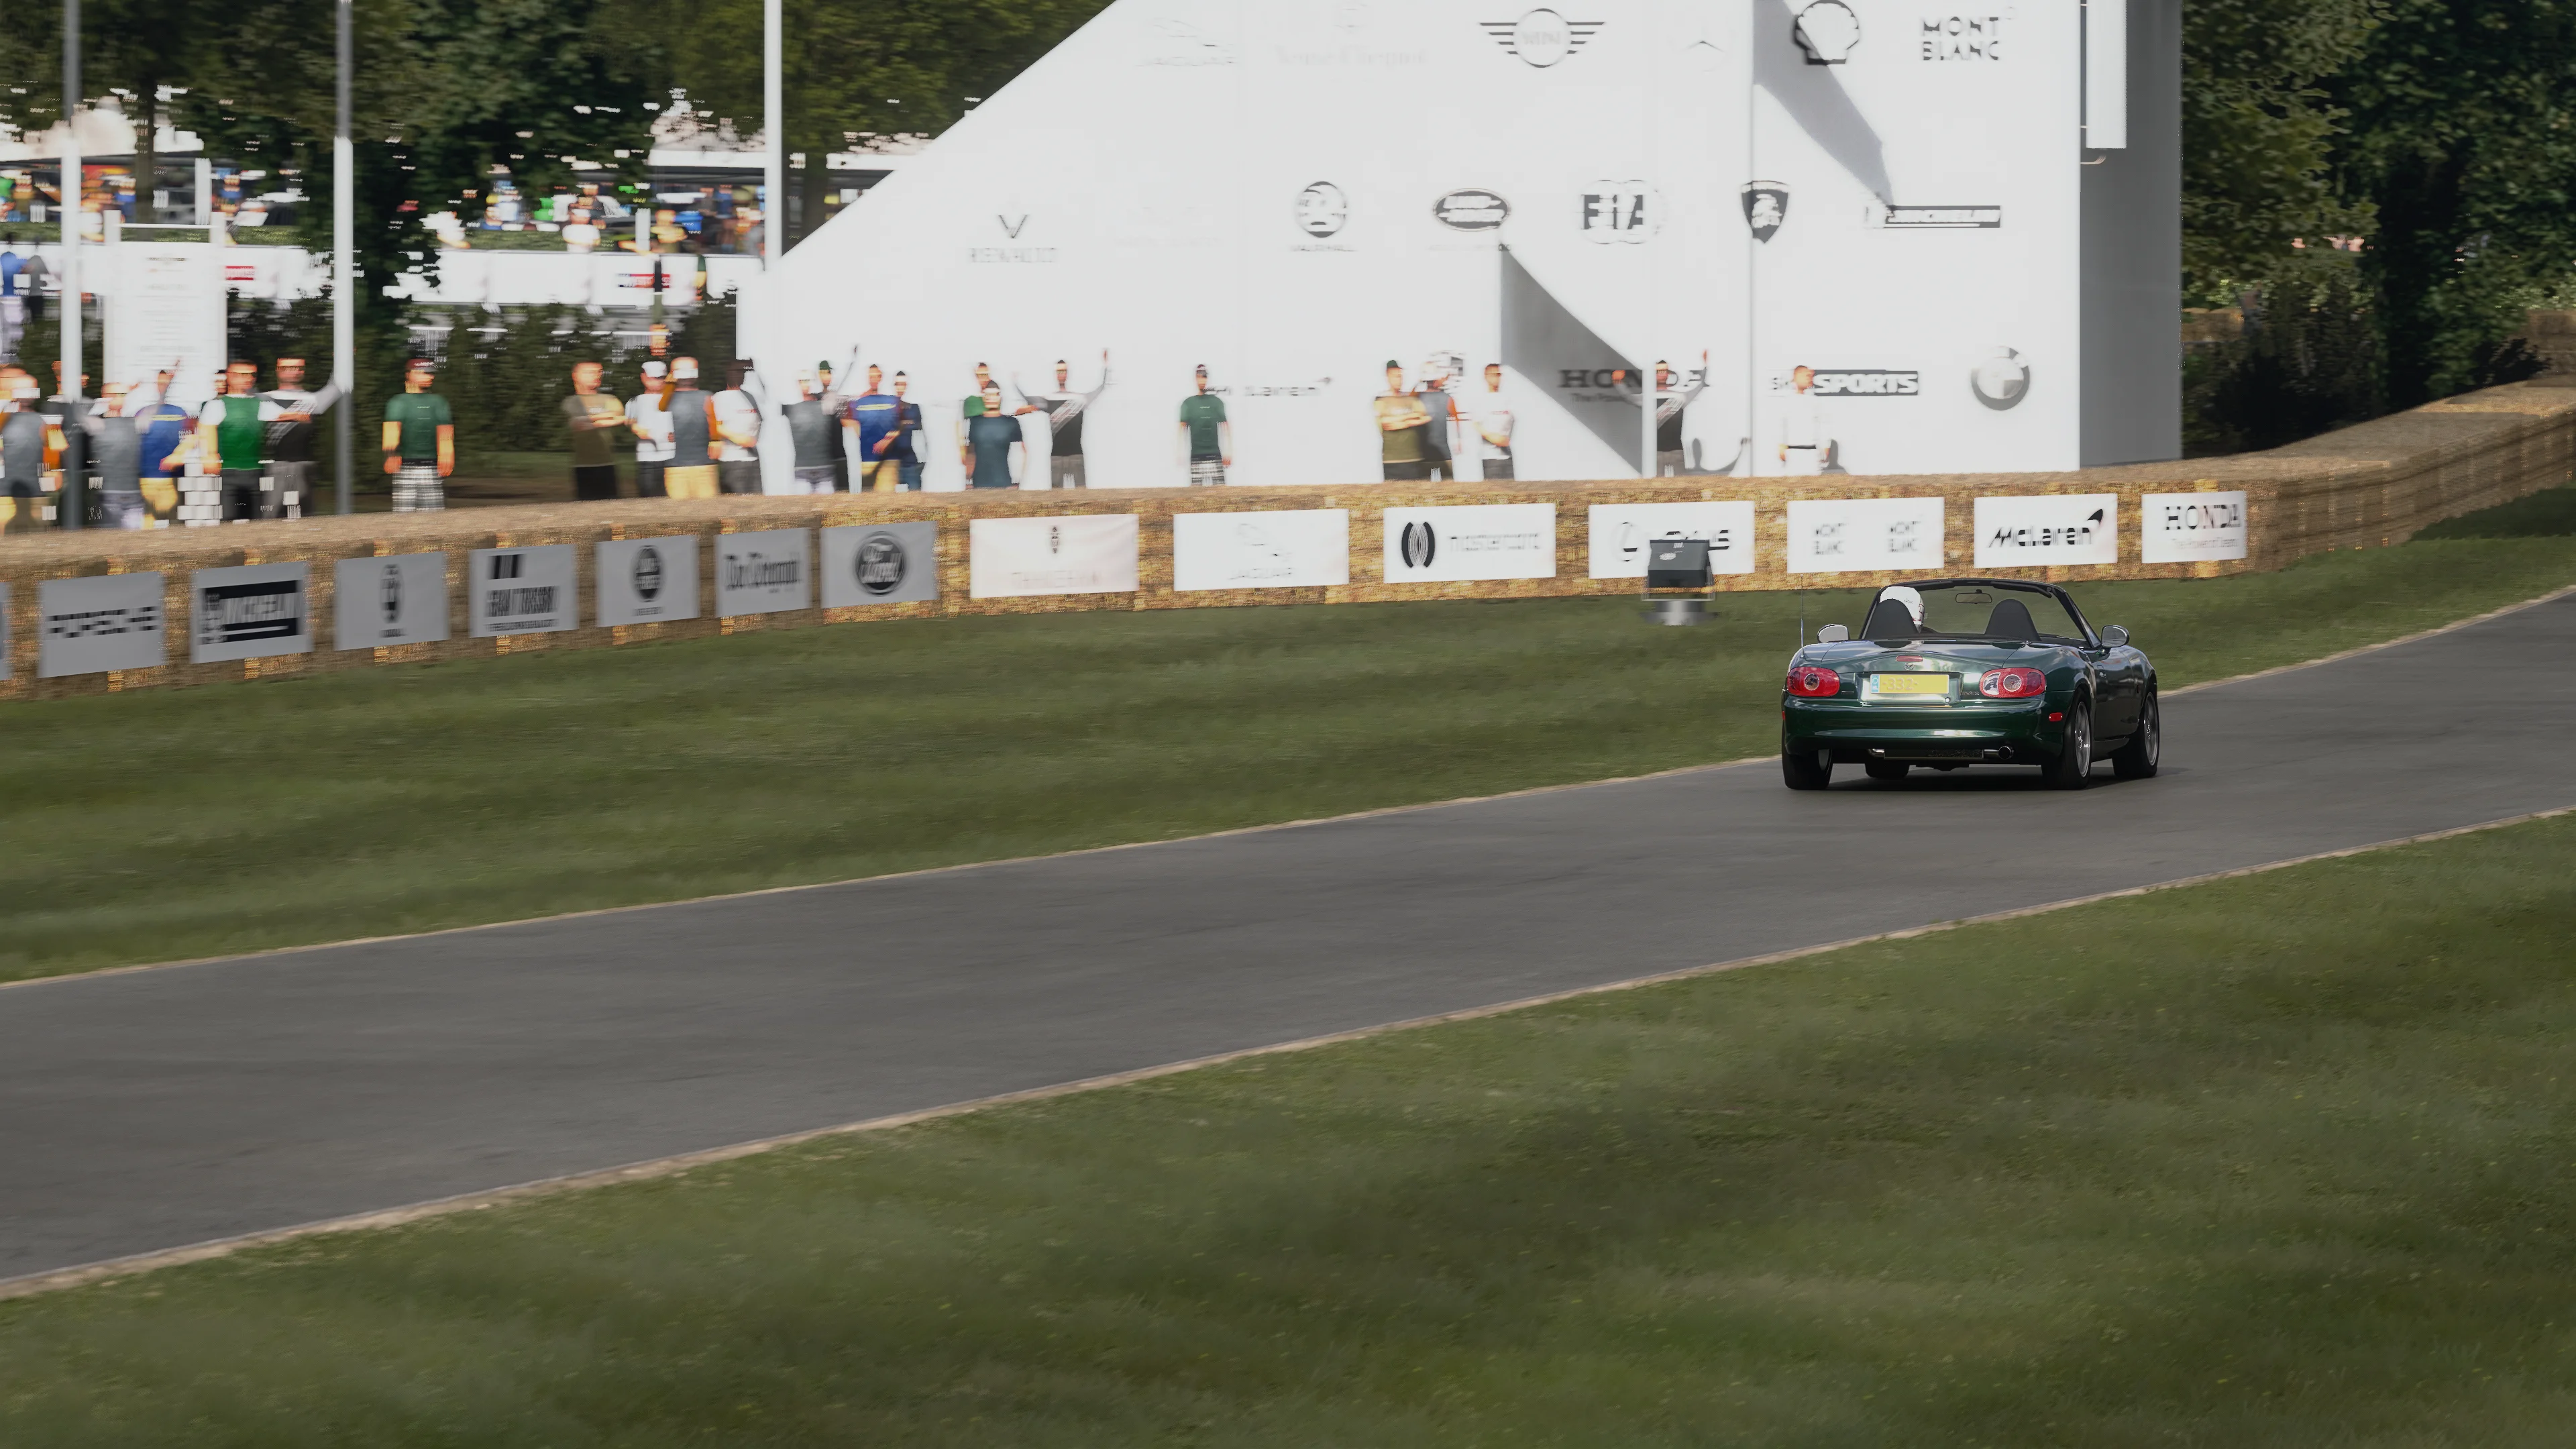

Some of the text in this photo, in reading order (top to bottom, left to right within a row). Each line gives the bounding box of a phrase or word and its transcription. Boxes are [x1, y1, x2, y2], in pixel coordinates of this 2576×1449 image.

[1920, 16, 2000, 37] MONT
[1921, 40, 2001, 61] BLANC
[1582, 194, 1645, 229] FIA
[1813, 374, 1918, 393] SPORTS
[1988, 527, 2093, 549] McLaren
